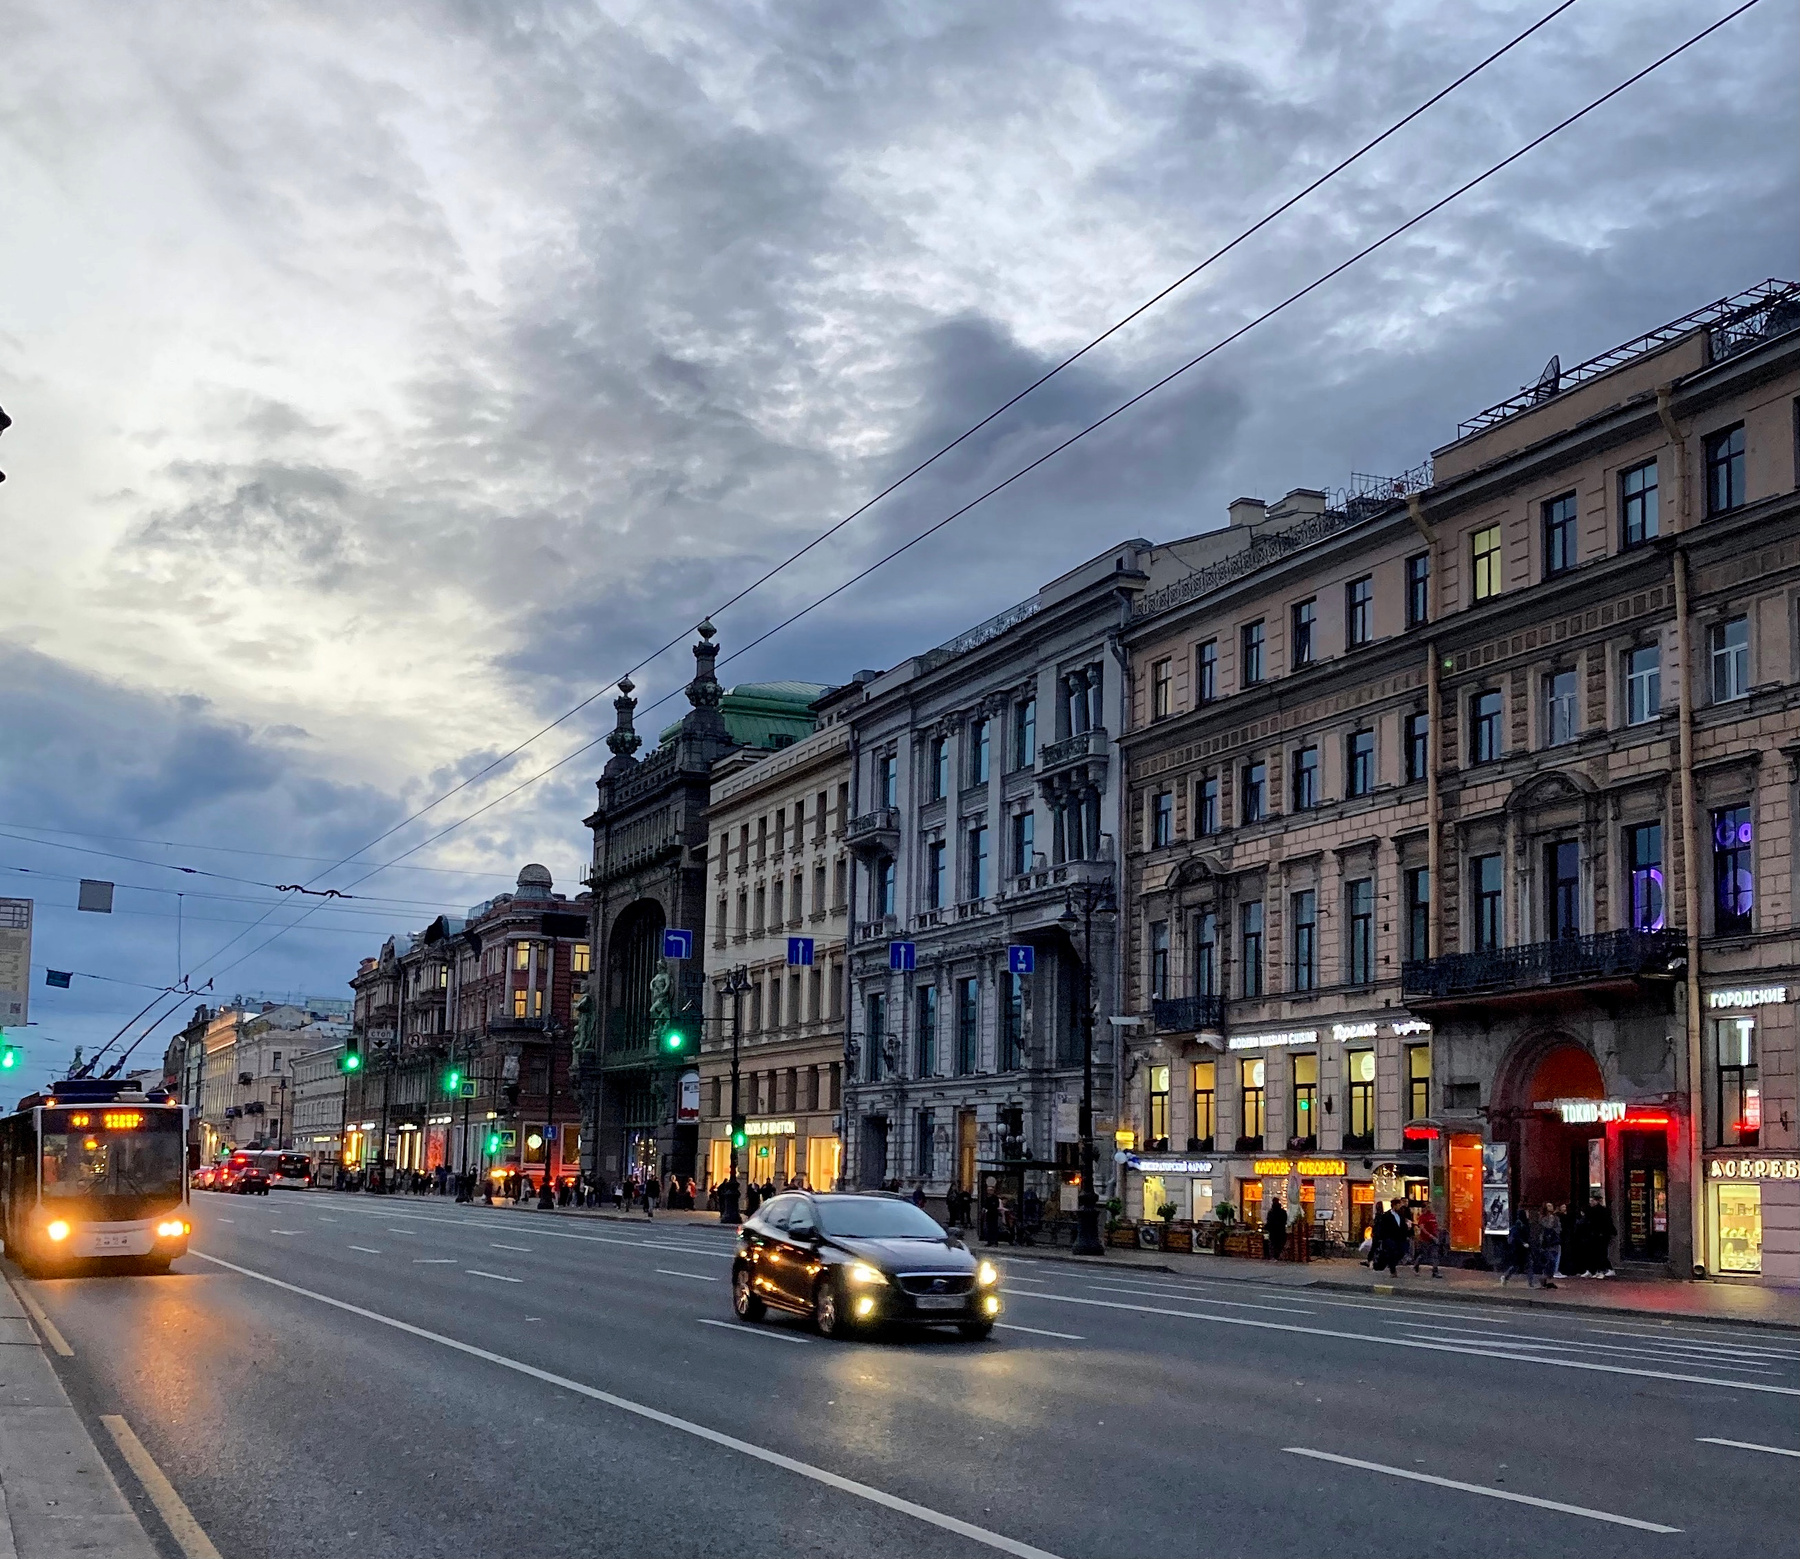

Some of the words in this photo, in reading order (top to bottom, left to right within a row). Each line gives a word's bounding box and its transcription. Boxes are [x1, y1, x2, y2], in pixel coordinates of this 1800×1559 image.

[1710, 987, 1786, 1009] ГОРОДСКИЕ
[1288, 1030, 1318, 1044] CUISINE
[1297, 1161, 1345, 1175] ПИВОВАРЫ
